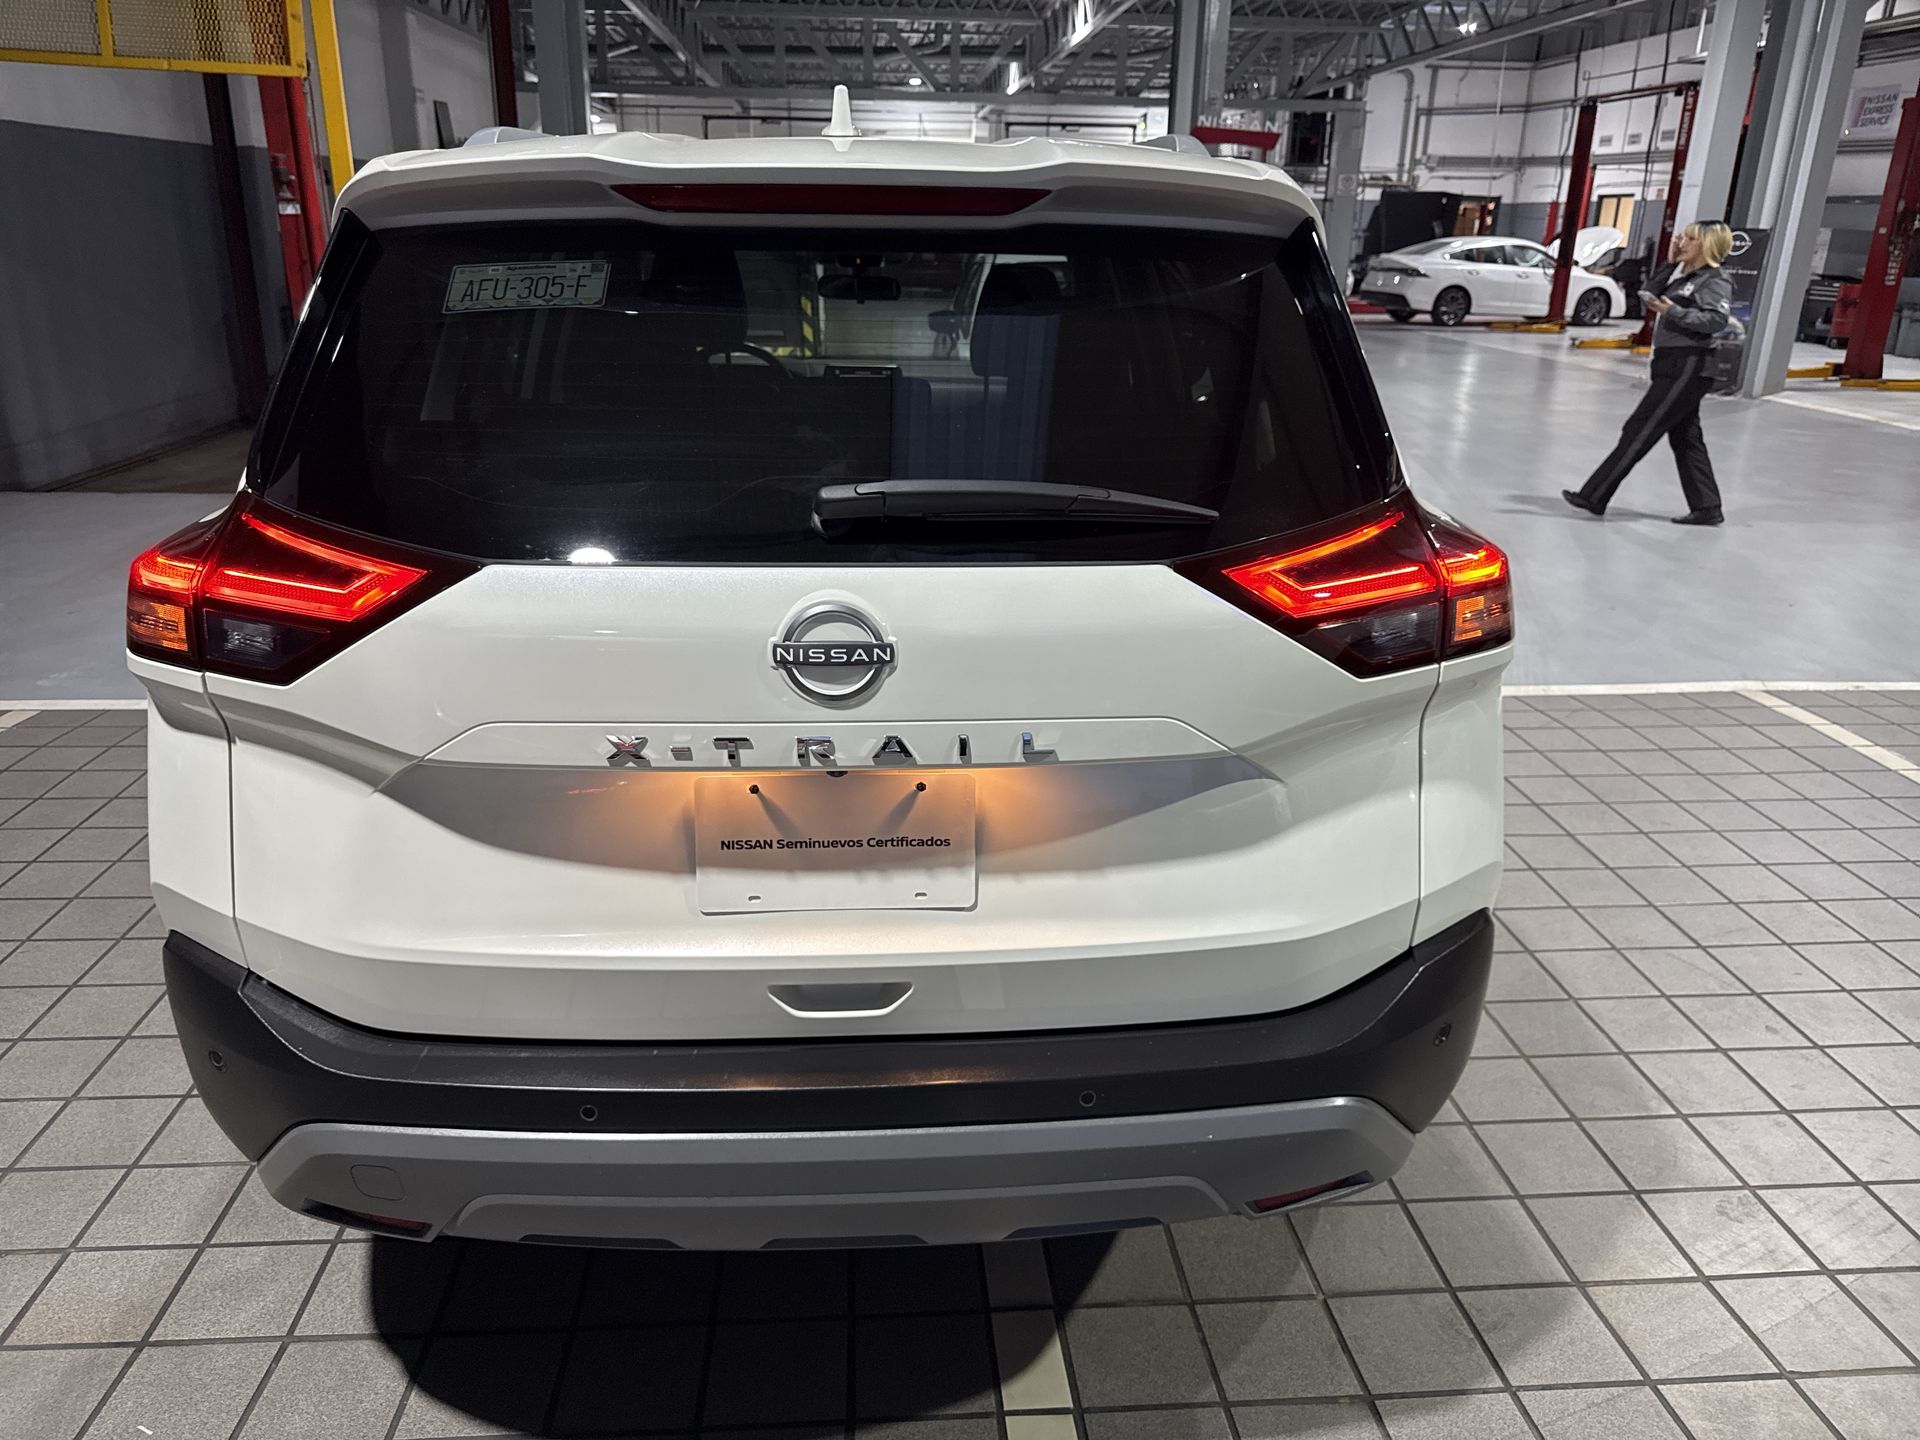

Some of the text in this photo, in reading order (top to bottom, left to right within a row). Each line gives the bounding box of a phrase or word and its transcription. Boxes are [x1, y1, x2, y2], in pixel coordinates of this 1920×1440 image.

[460, 275, 592, 302] AFU-305-F
[776, 646, 891, 662] NISSAN
[605, 731, 1058, 767] X-TRAIL
[720, 836, 951, 850] NISSAN Seminuevos Certificados
